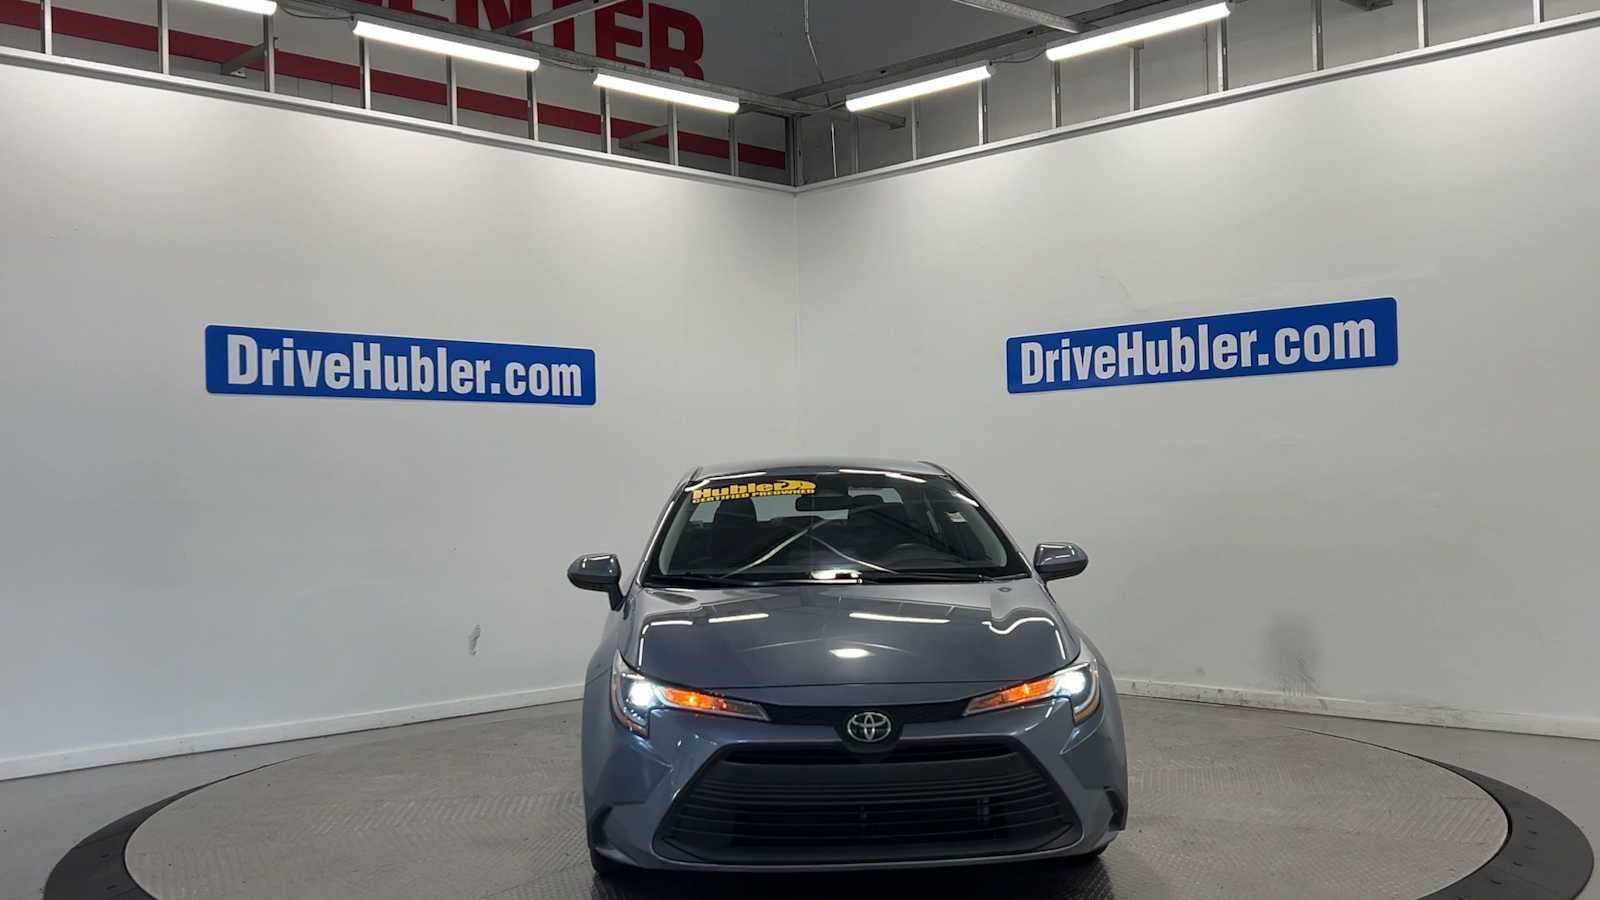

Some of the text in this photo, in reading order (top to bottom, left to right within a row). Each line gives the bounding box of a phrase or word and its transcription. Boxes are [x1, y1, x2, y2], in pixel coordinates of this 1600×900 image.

[226, 333, 583, 397] DriveHubler.com
[1020, 317, 1376, 385] DriveHubler.com
[692, 481, 796, 499] Hubler
